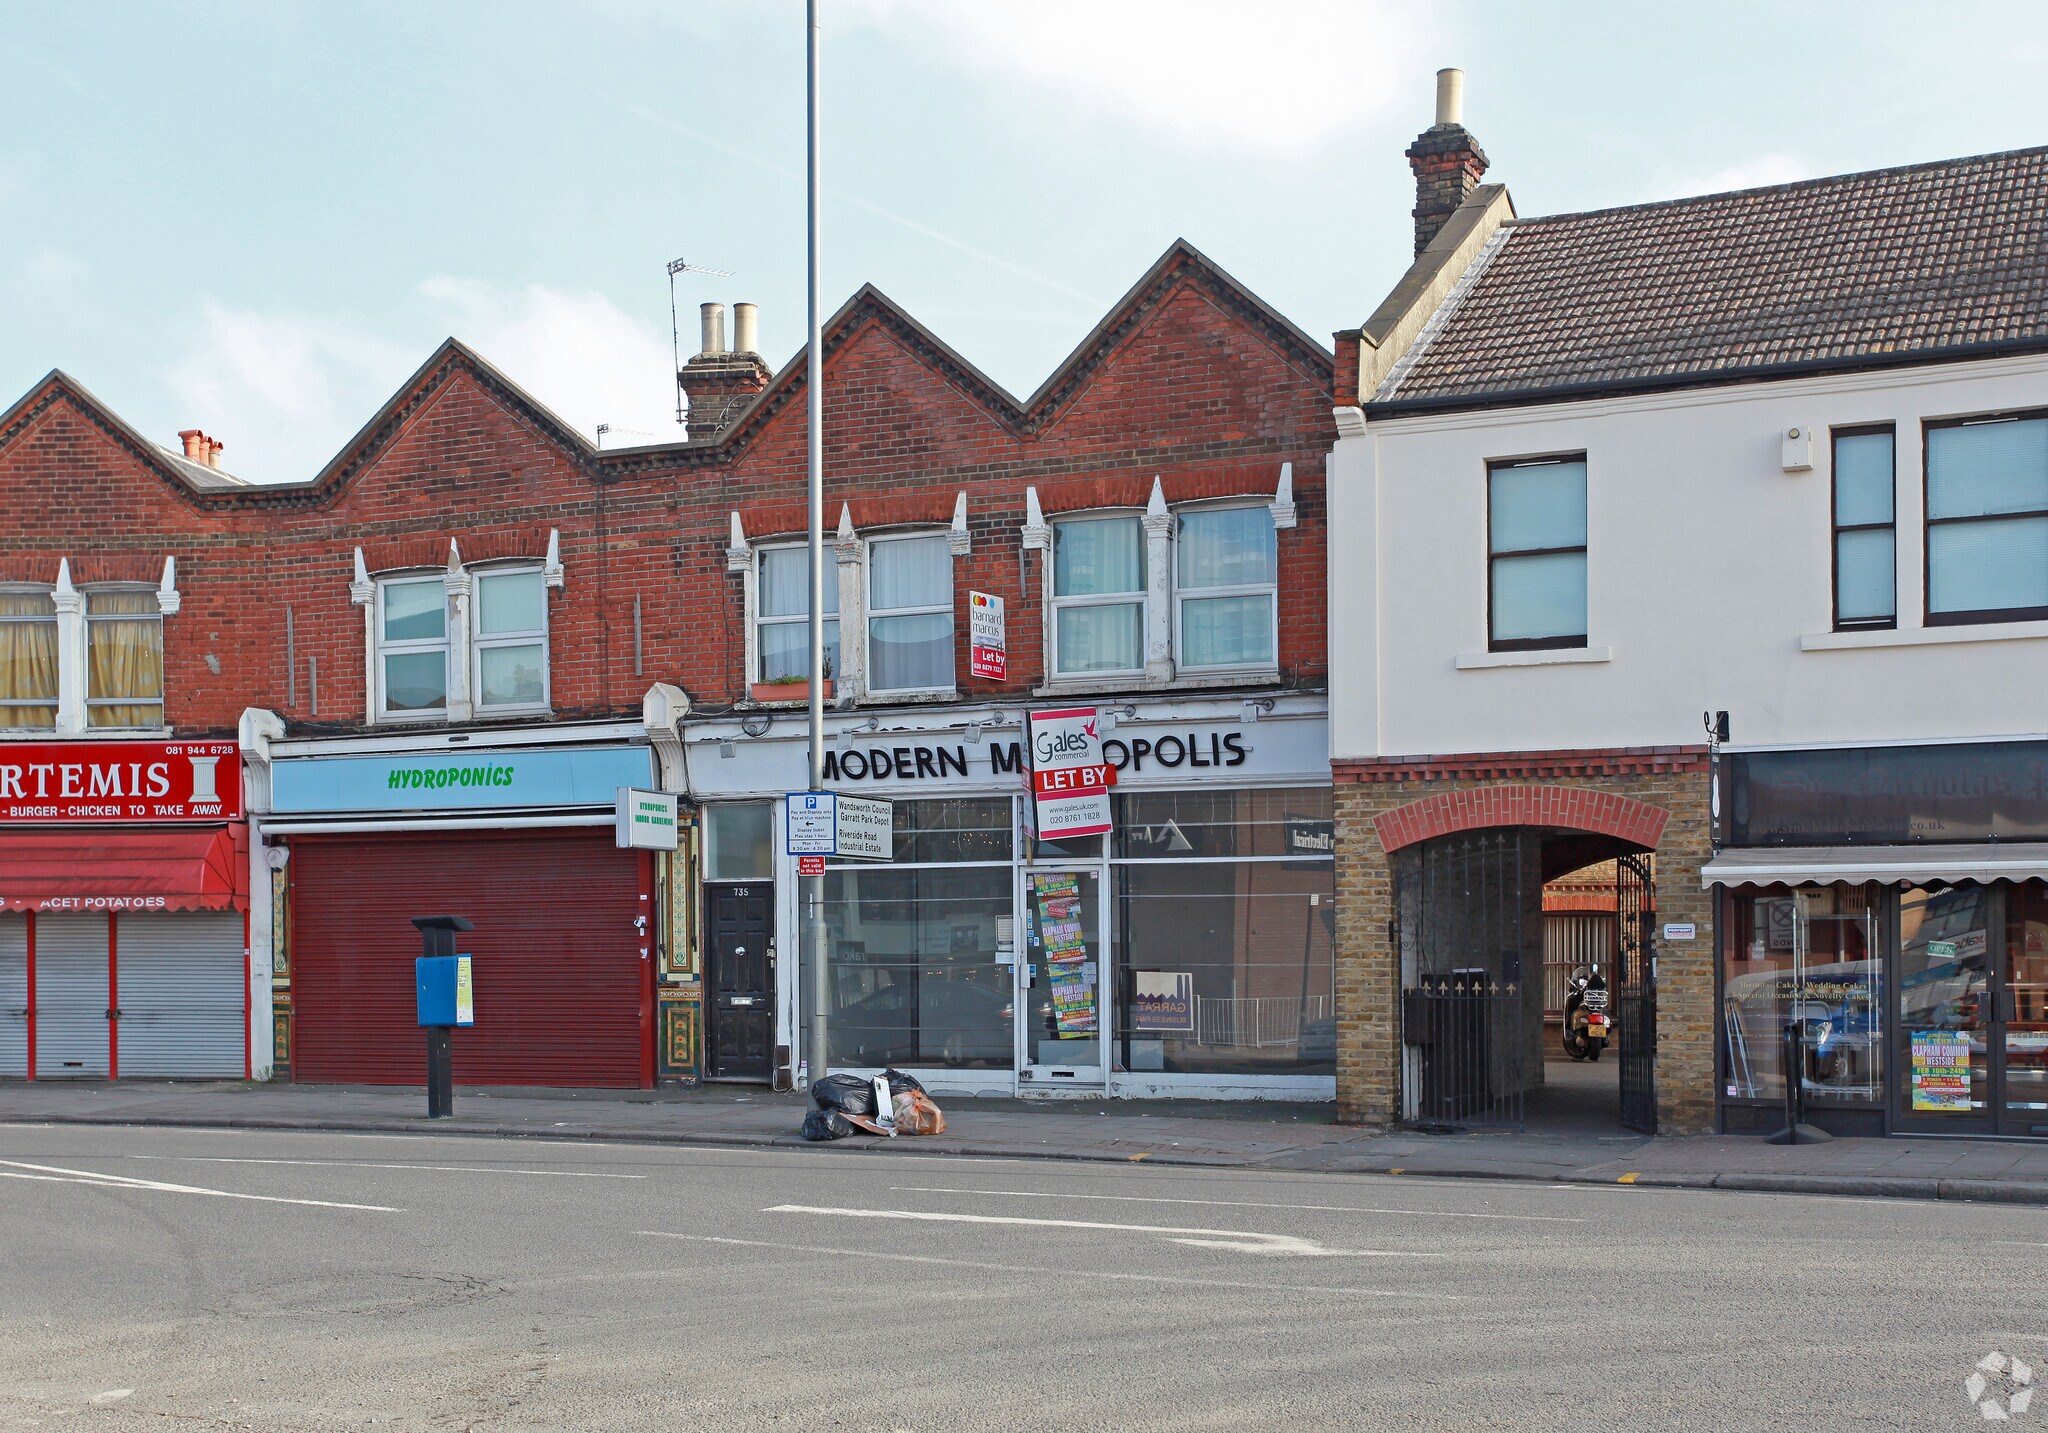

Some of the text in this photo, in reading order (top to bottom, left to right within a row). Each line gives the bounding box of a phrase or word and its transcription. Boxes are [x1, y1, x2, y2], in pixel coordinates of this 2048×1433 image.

[972, 608, 1002, 625] barnard
[972, 623, 1000, 636] marcus
[982, 651, 1005, 666] Let by
[166, 746, 234, 755] 081 944 6728
[1035, 729, 1088, 763] Gales
[807, 732, 1245, 781] MODERN MOPOLIS
[1054, 750, 1090, 761] commercial
[388, 765, 514, 789] HYDROPONICS
[1043, 770, 1077, 790] LET
[1082, 766, 1107, 786] BY
[640, 802, 668, 813] HYDROPONICS
[807, 798, 815, 808] P
[838, 800, 891, 815] Wandsworth Council
[1049, 803, 1099, 814] www.gales.uk.com
[10, 804, 223, 817] BURGER CHICKEN TO TAKE AWAY
[635, 815, 673, 826] INDOOR GARDENING
[840, 812, 889, 826] Garratt Park Depot
[1050, 812, 1100, 824] 020 8761 1828
[838, 829, 878, 841] Riverside Road
[838, 841, 882, 853] Industrial Estate
[733, 888, 749, 896] 735
[85, 897, 165, 907] POTATOES
[1930, 944, 1953, 954] OPEN
[1052, 985, 1074, 997] CLAPHAM
[1740, 981, 1773, 990] Birthday
[1806, 981, 1841, 991] Wedding
[1843, 981, 1867, 990] Cakes
[1738, 992, 1765, 1000] Special
[1813, 992, 1842, 1001] Novelty
[1845, 992, 1871, 1000] Cakes
[1912, 1045, 1969, 1057] CLAPHAM COMMON
[1926, 1056, 1955, 1066] WESTSIDE
